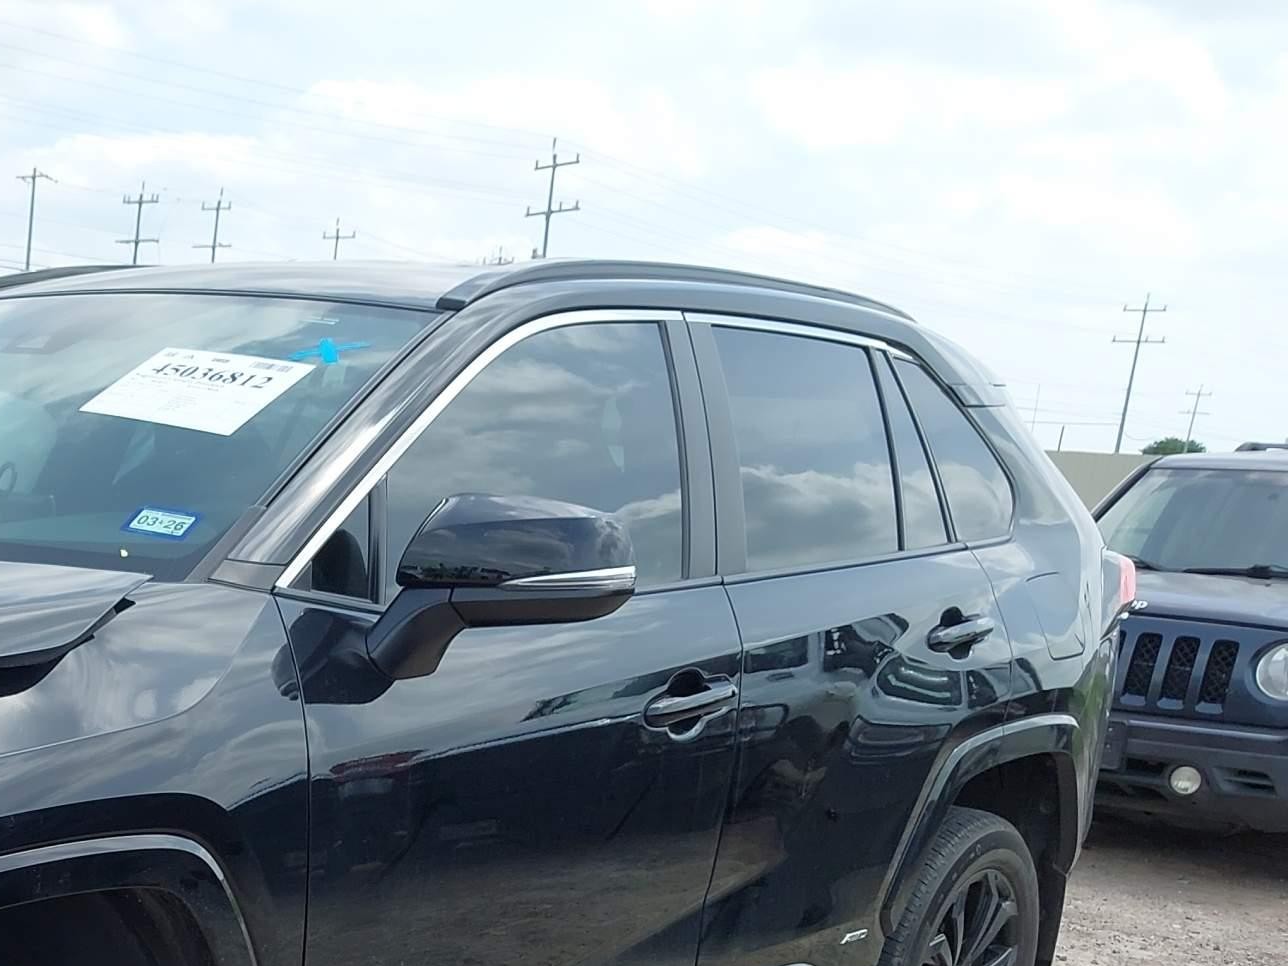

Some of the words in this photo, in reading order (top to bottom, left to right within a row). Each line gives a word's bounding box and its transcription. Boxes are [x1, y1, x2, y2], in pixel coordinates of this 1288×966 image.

[152, 362, 274, 389] 45036812
[136, 515, 159, 527] 03
[163, 520, 187, 531] 26
